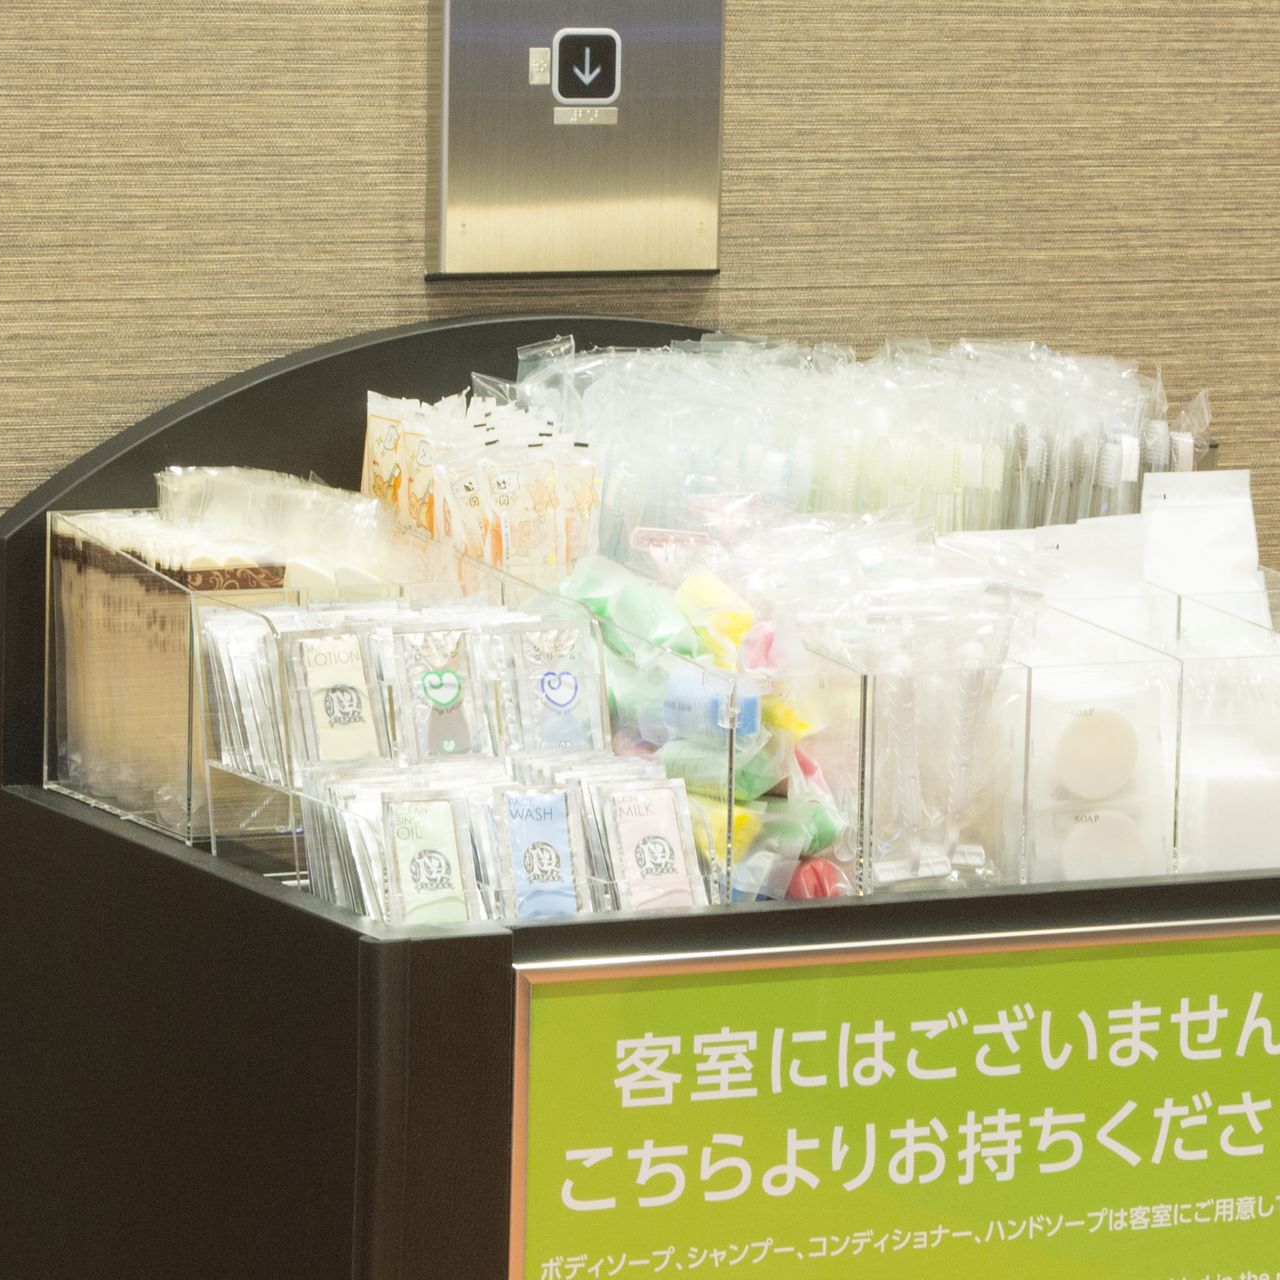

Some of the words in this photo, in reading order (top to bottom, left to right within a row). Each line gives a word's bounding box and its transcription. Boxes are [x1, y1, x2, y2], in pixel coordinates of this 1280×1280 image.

[305, 649, 361, 668] LOTION
[508, 806, 554, 821] WASH
[618, 800, 656, 818] MILK
[1072, 814, 1100, 826] SOAP
[395, 824, 424, 841] OIL
